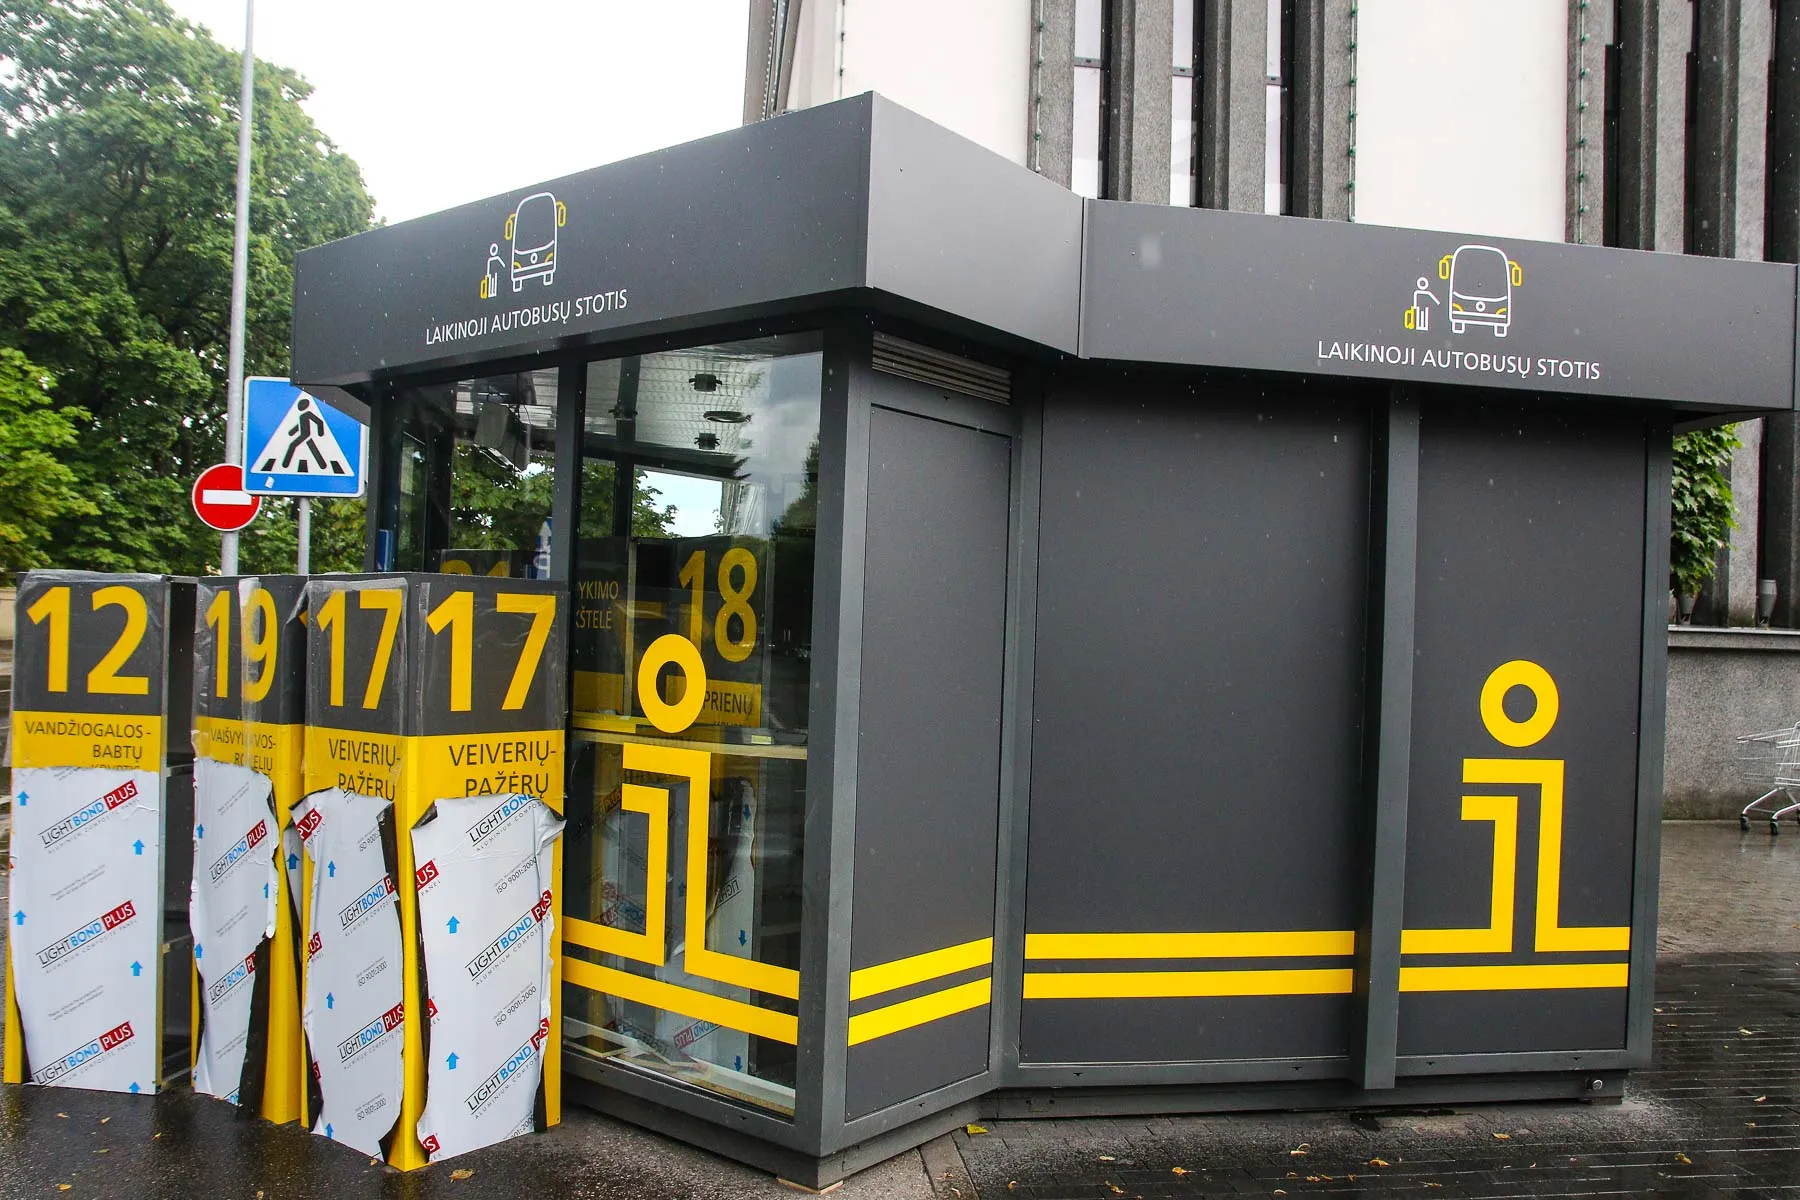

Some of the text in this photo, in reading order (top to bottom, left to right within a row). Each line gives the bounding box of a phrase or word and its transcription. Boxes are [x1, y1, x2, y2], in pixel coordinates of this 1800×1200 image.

[426, 289, 628, 345] LAIKINOJI AUTOBUSŲ STOTIS
[1318, 340, 1600, 380] LAIKINOJI AUTOBUSŲ STOTIS
[679, 547, 758, 662] 18
[27, 586, 149, 695] 12
[205, 588, 278, 703] 19
[316, 589, 403, 710] 17
[426, 591, 557, 712] 17
[93, 745, 143, 763] BABTŲ
[328, 738, 400, 772] VEIVERIŲ-
[449, 740, 557, 767] VEIVERIŲ-
[465, 770, 549, 799] PAŽĖRŲ
[42, 802, 105, 845] LIGHTBOND
[106, 783, 136, 807] PLUS
[248, 823, 266, 847] PLUS
[416, 865, 436, 889] US
[340, 885, 385, 927] LIGHTBOND
[39, 904, 134, 965] LIGHTBOND PLUS
[468, 916, 533, 977] LIGHTBOND
[339, 1021, 384, 1060] LIGHTBOND
[384, 1005, 404, 1030] PLUS
[496, 1013, 508, 1026] ISO
[36, 1025, 132, 1085] LIGHTBOND PLUS
[468, 1045, 532, 1110] LIGHTBOND
